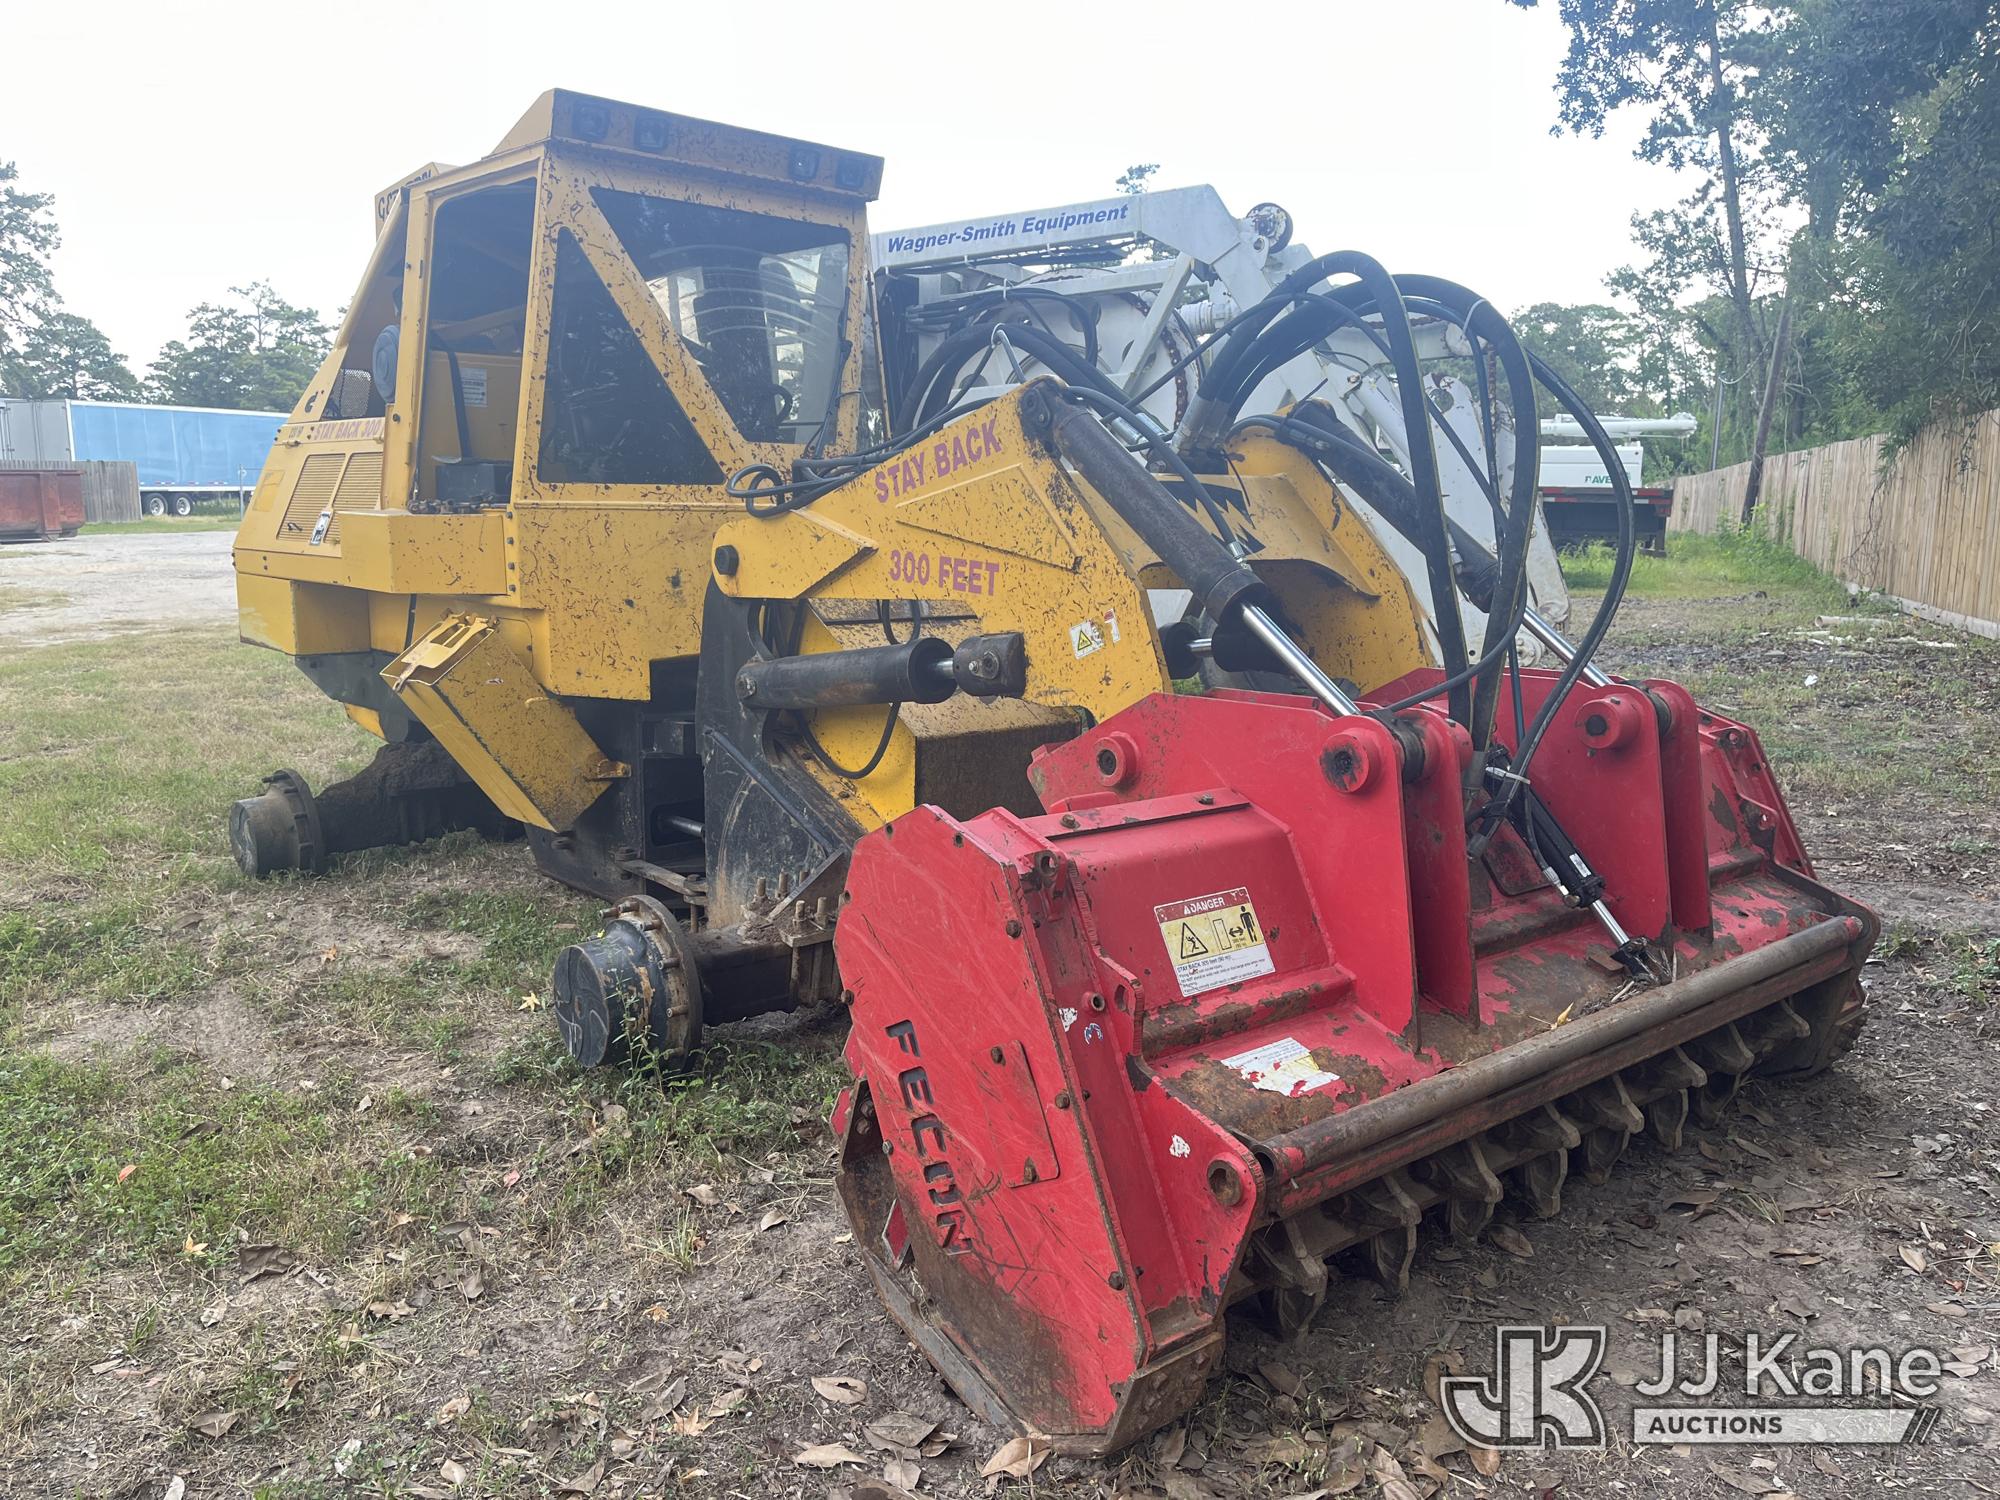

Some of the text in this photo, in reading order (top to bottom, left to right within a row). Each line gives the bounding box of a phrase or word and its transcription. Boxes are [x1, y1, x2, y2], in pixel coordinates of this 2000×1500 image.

[888, 203, 1129, 253] Wagner-Smith Equipment
[314, 424, 335, 441] STAY
[335, 422, 360, 440] BACK
[874, 418, 1002, 503] STAY BACK
[889, 550, 1000, 596] 300 FEET
[1190, 897, 1226, 913] DANGER
[884, 1019, 974, 1255] FECON
